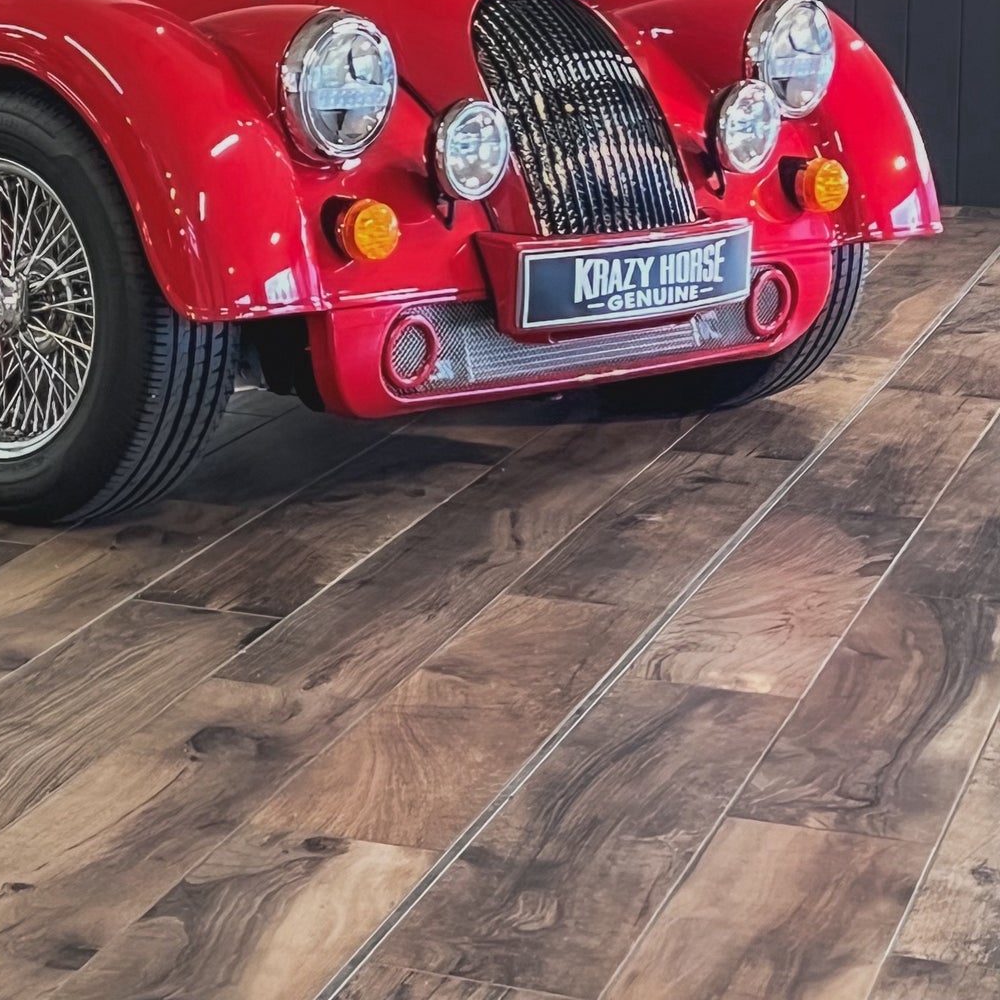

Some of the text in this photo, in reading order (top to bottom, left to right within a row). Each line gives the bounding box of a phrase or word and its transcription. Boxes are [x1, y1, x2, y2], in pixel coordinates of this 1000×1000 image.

[575, 239, 726, 303] KRAZY HORSE
[608, 285, 698, 310] GENUINE
